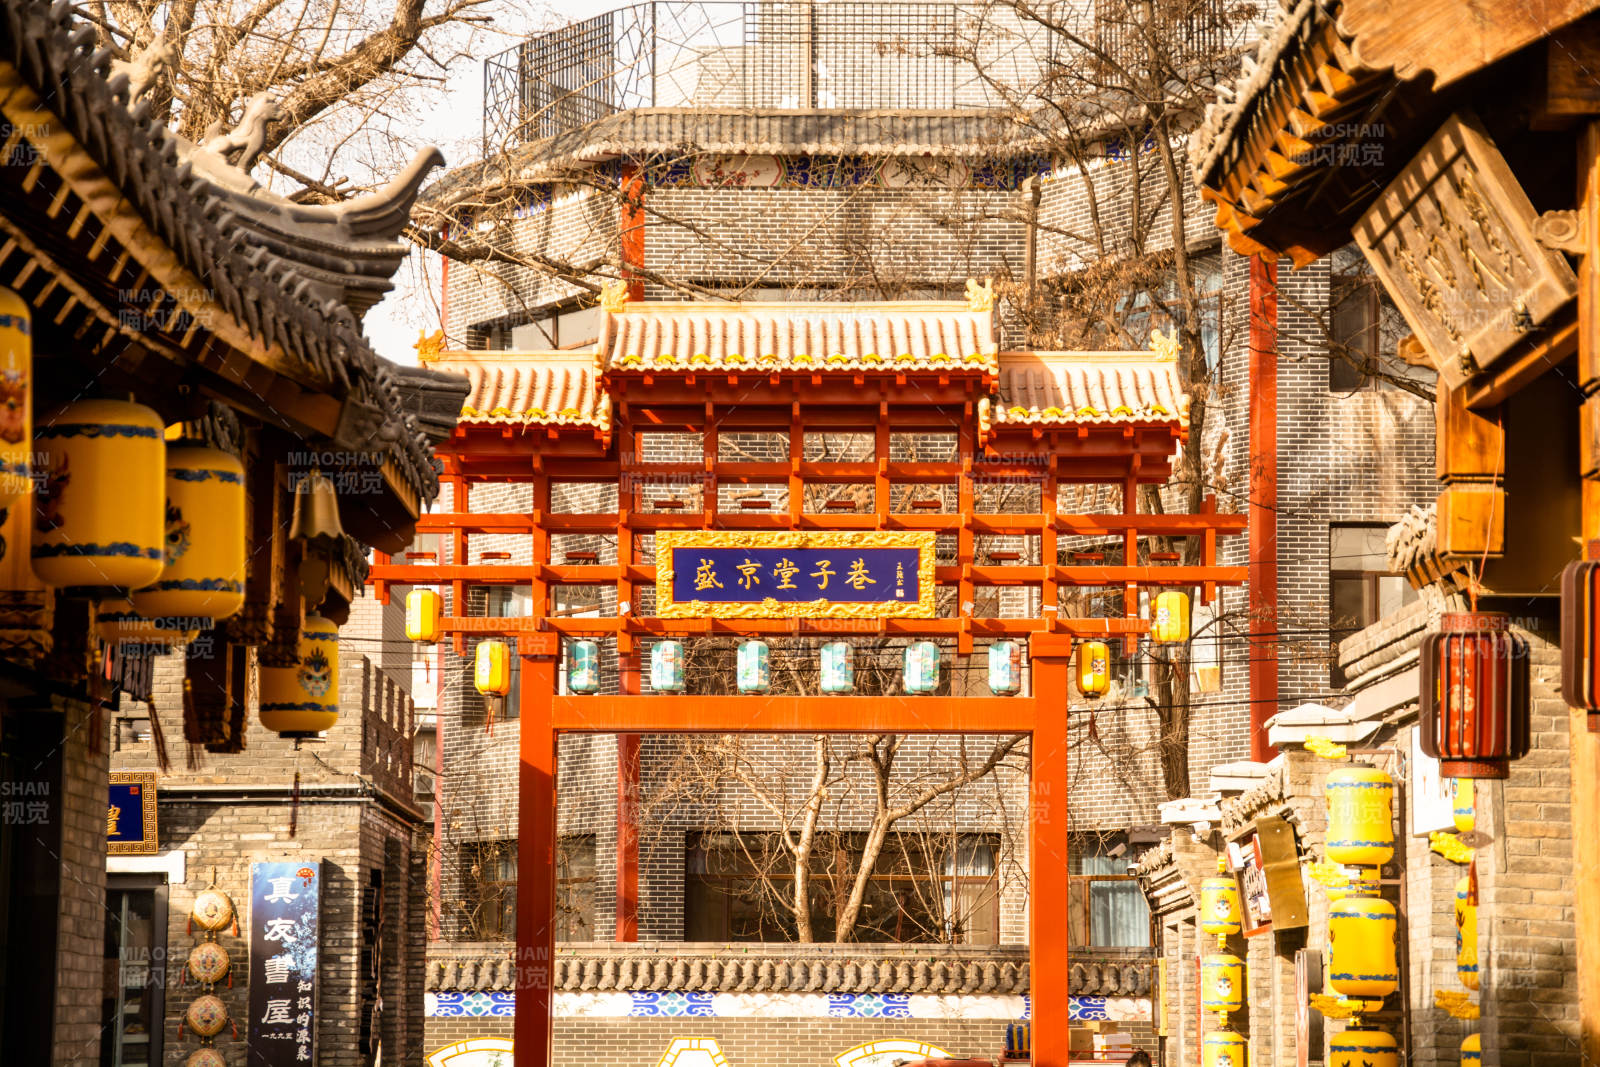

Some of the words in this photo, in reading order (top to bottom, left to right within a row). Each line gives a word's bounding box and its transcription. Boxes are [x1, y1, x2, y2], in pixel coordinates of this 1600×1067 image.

[694, 558, 877, 590] 盛京堂子巷
[296, 979, 313, 1061] 知识的源泉
